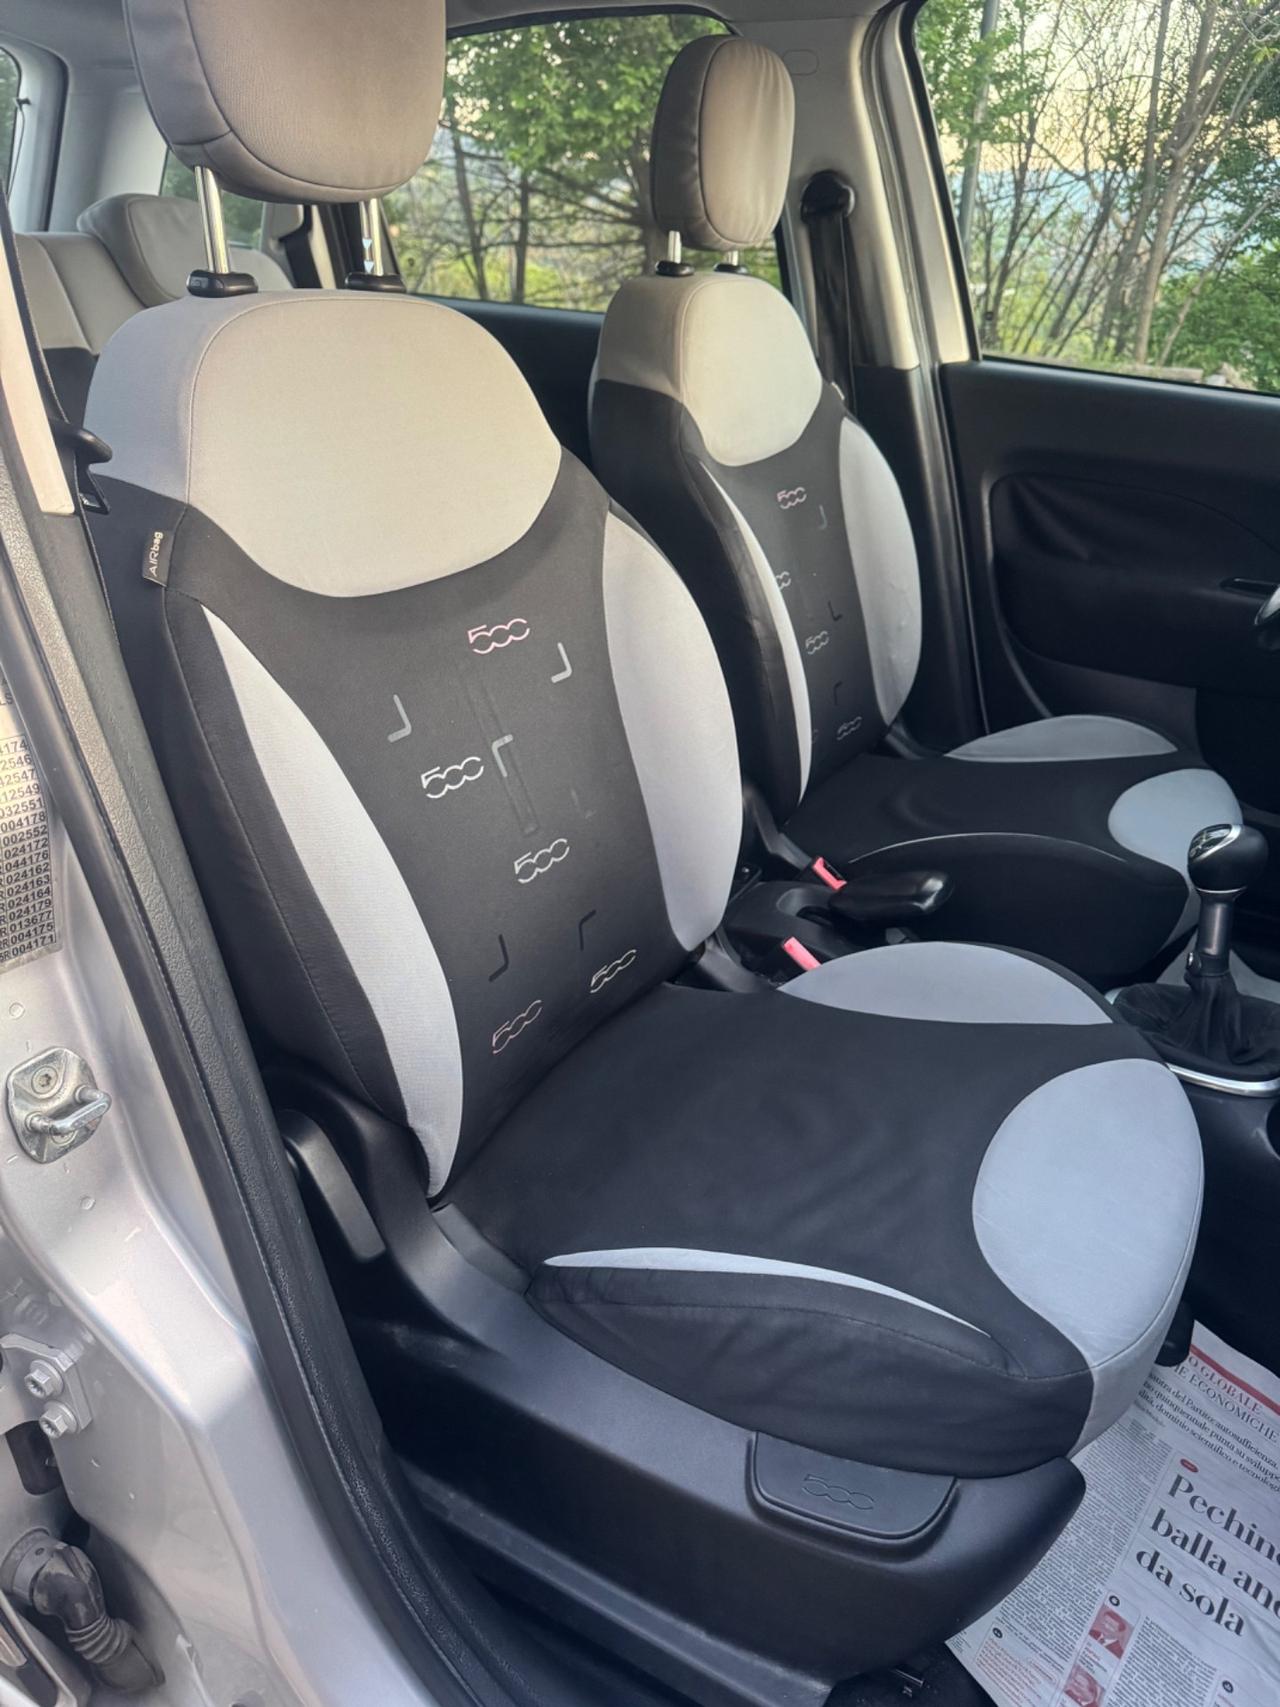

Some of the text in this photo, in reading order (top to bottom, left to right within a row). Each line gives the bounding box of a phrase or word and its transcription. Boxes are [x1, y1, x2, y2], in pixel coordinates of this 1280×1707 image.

[149, 532, 164, 577] AIRbag
[468, 618, 530, 655] 500
[0, 739, 27, 755] 174
[421, 756, 484, 800] 500
[514, 838, 571, 884] 500
[590, 949, 637, 993] 500
[492, 999, 542, 1055] 500
[1188, 1374, 1279, 1443] ECONOMICHE
[1200, 1365, 1264, 1415] GLOBALE
[1150, 1507, 1227, 1576] balla
[1136, 1550, 1245, 1636] da sola
